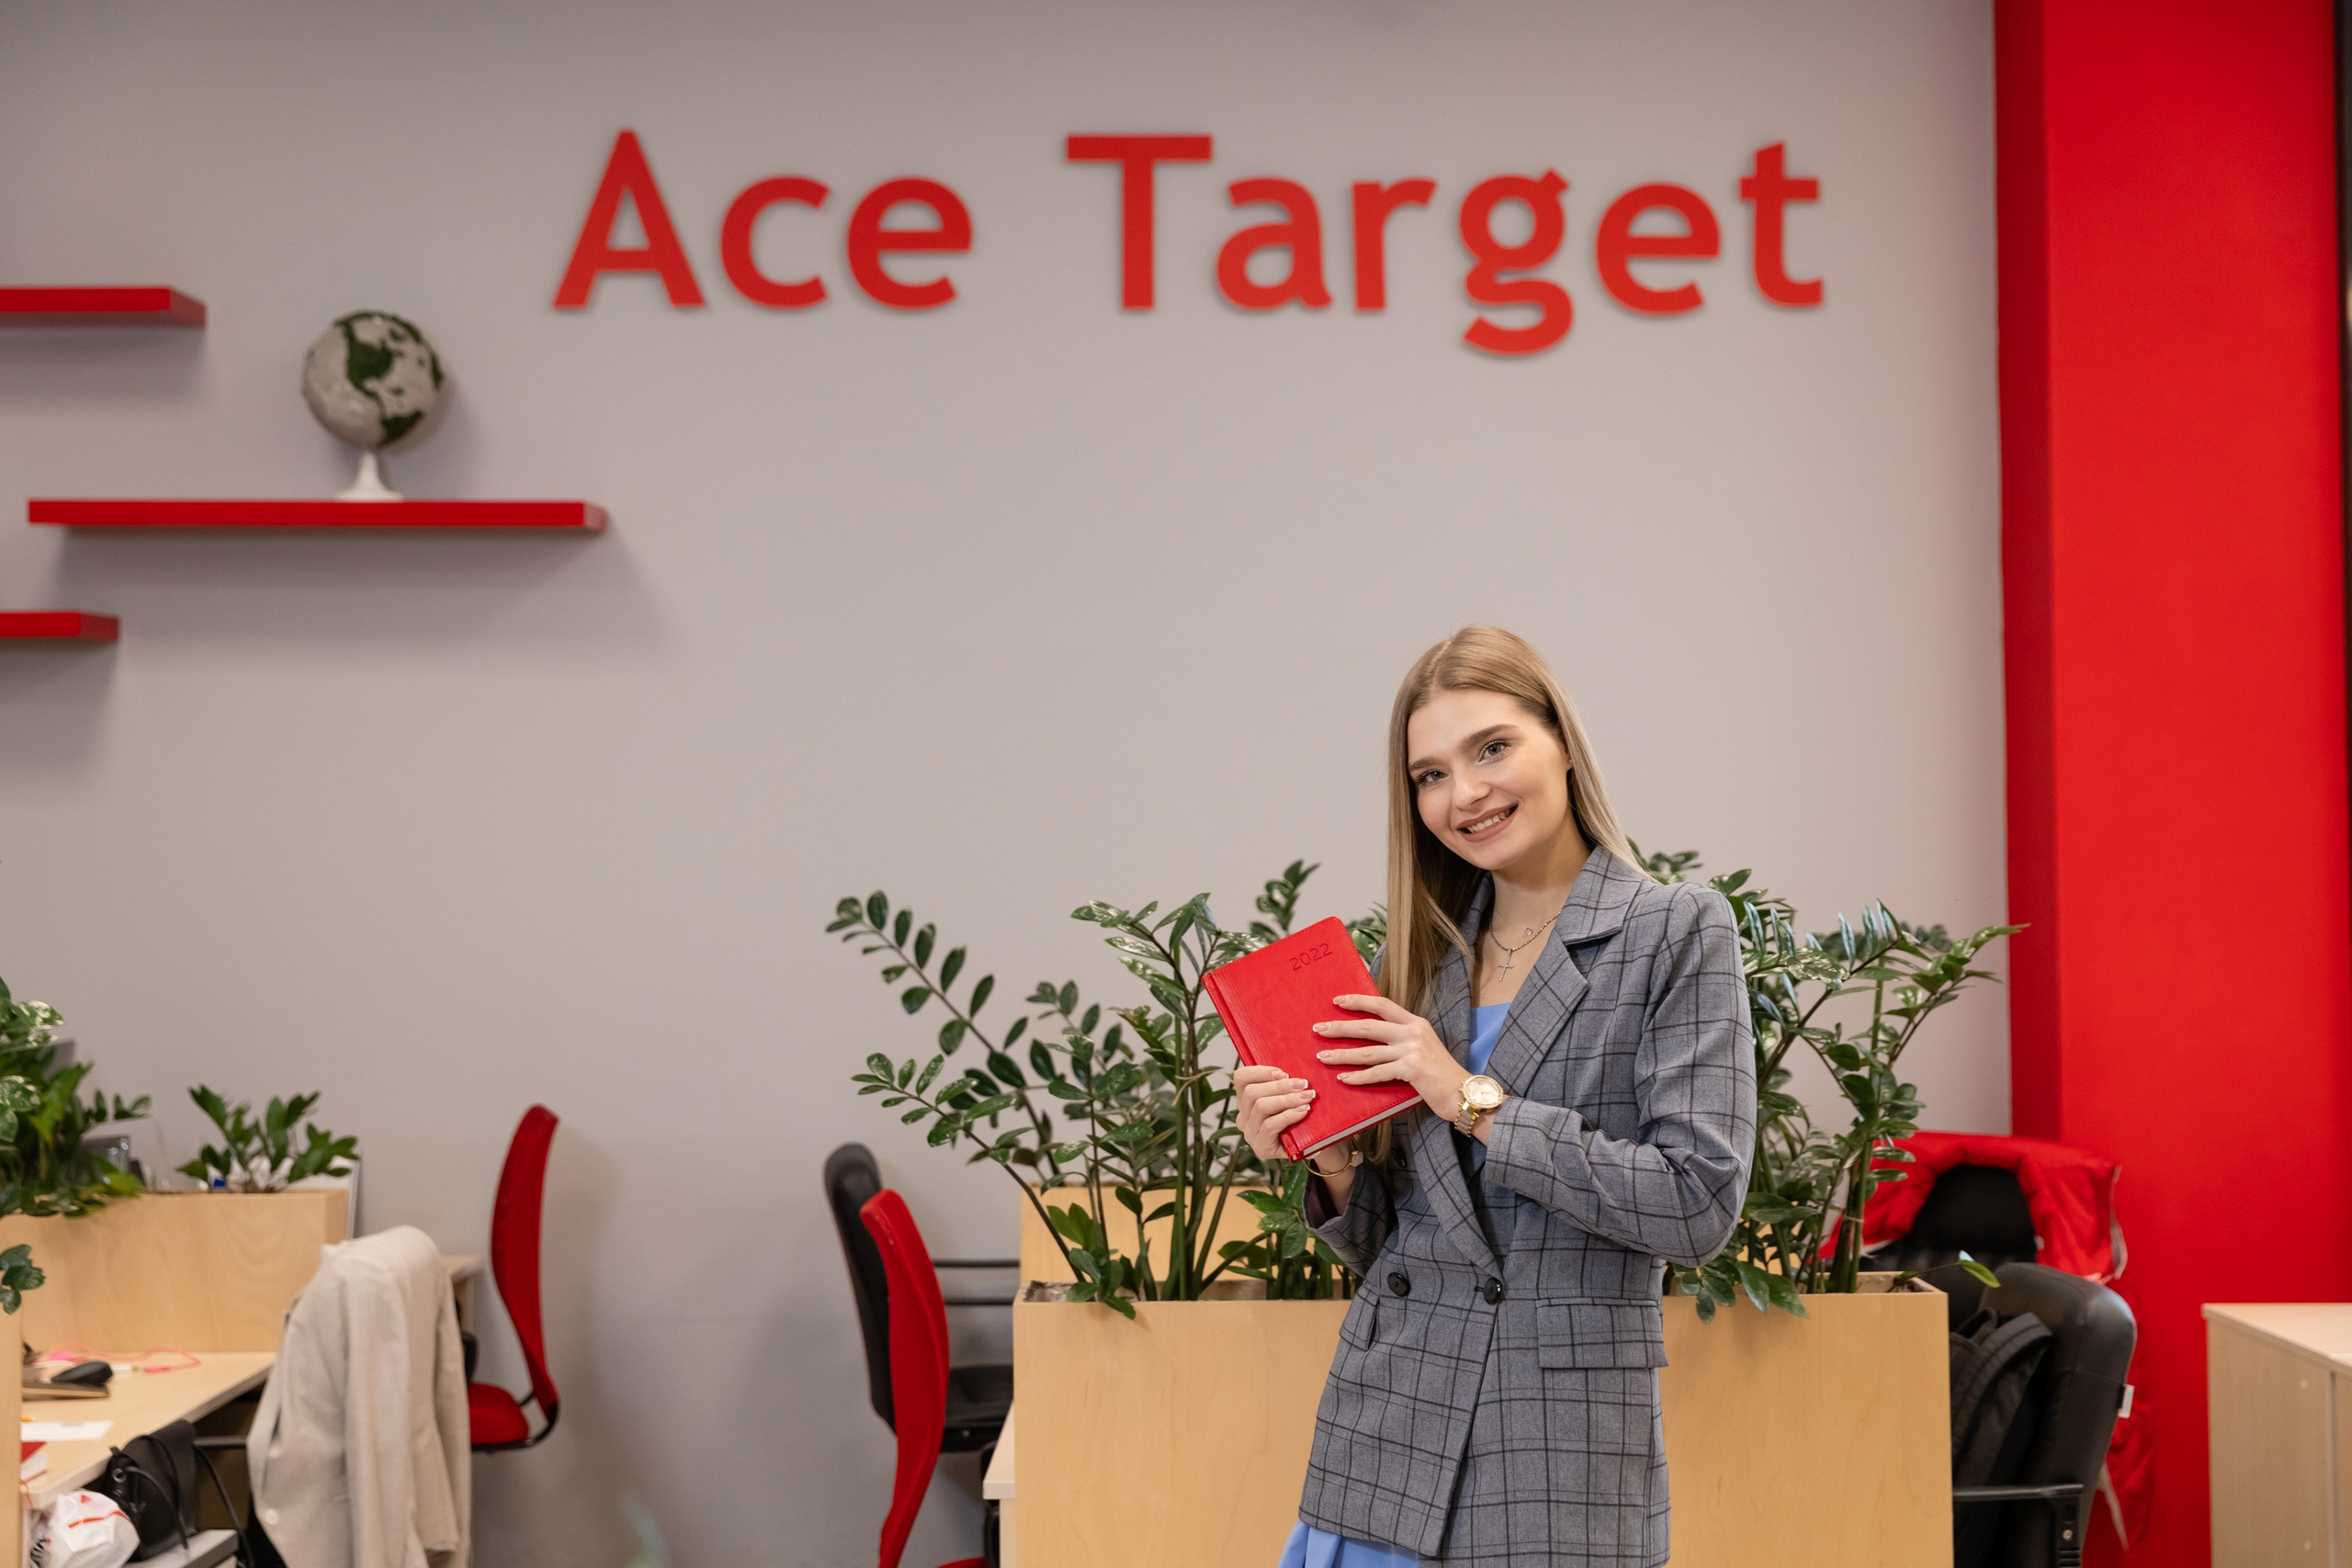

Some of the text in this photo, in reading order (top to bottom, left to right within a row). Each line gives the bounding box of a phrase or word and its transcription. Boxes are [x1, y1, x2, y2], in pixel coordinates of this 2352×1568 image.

[553, 130, 1824, 355] Ace Target
[1289, 942, 1333, 971] 2022
